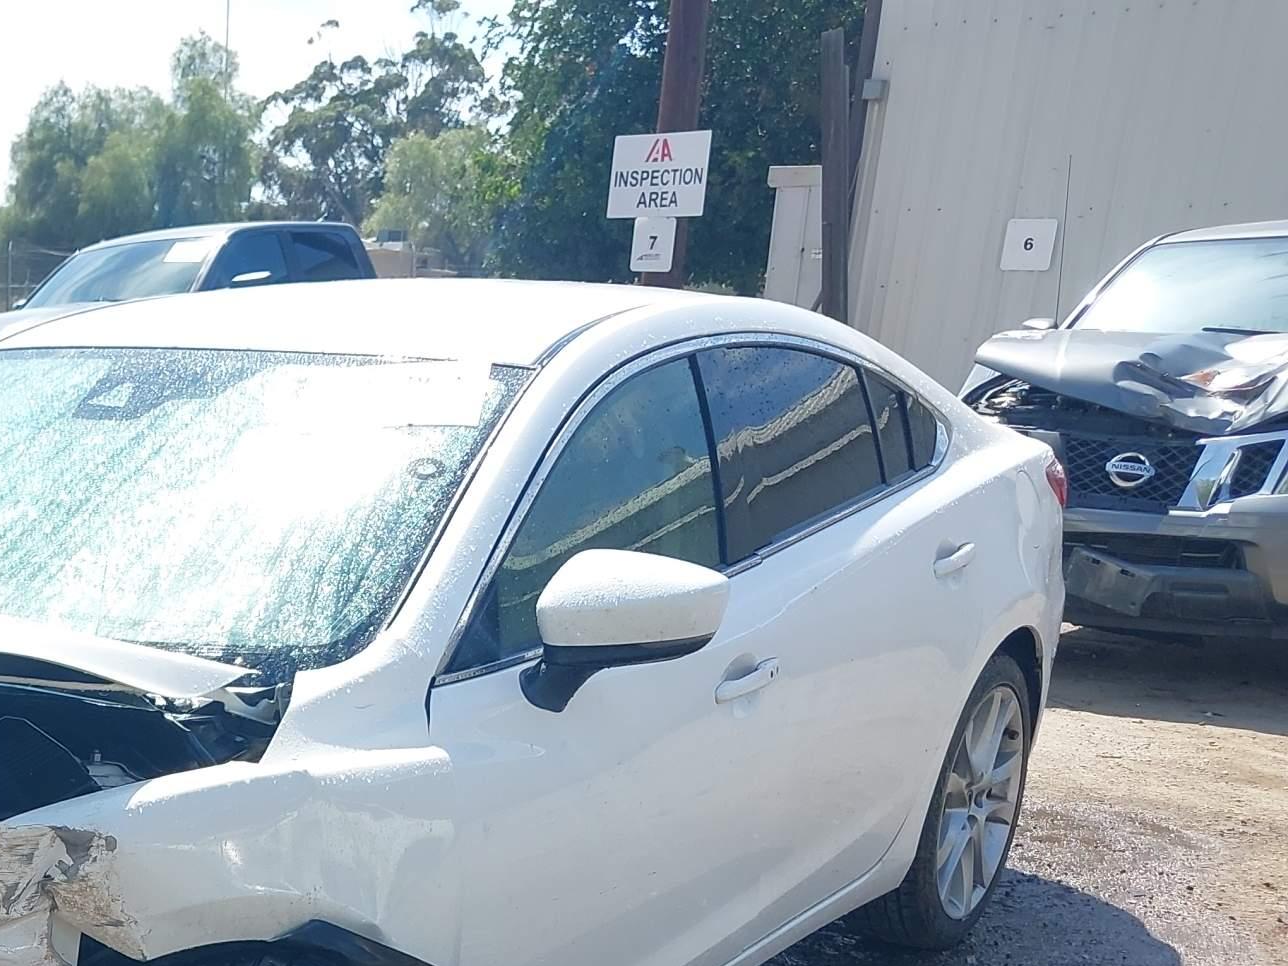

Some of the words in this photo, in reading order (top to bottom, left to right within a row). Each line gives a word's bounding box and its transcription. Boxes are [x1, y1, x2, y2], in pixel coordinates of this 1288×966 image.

[614, 167, 704, 188] INSPECTION
[636, 191, 678, 208] AREA
[649, 236, 658, 251] 7
[1023, 237, 1034, 251] 6
[1111, 463, 1151, 474] NISSAN
